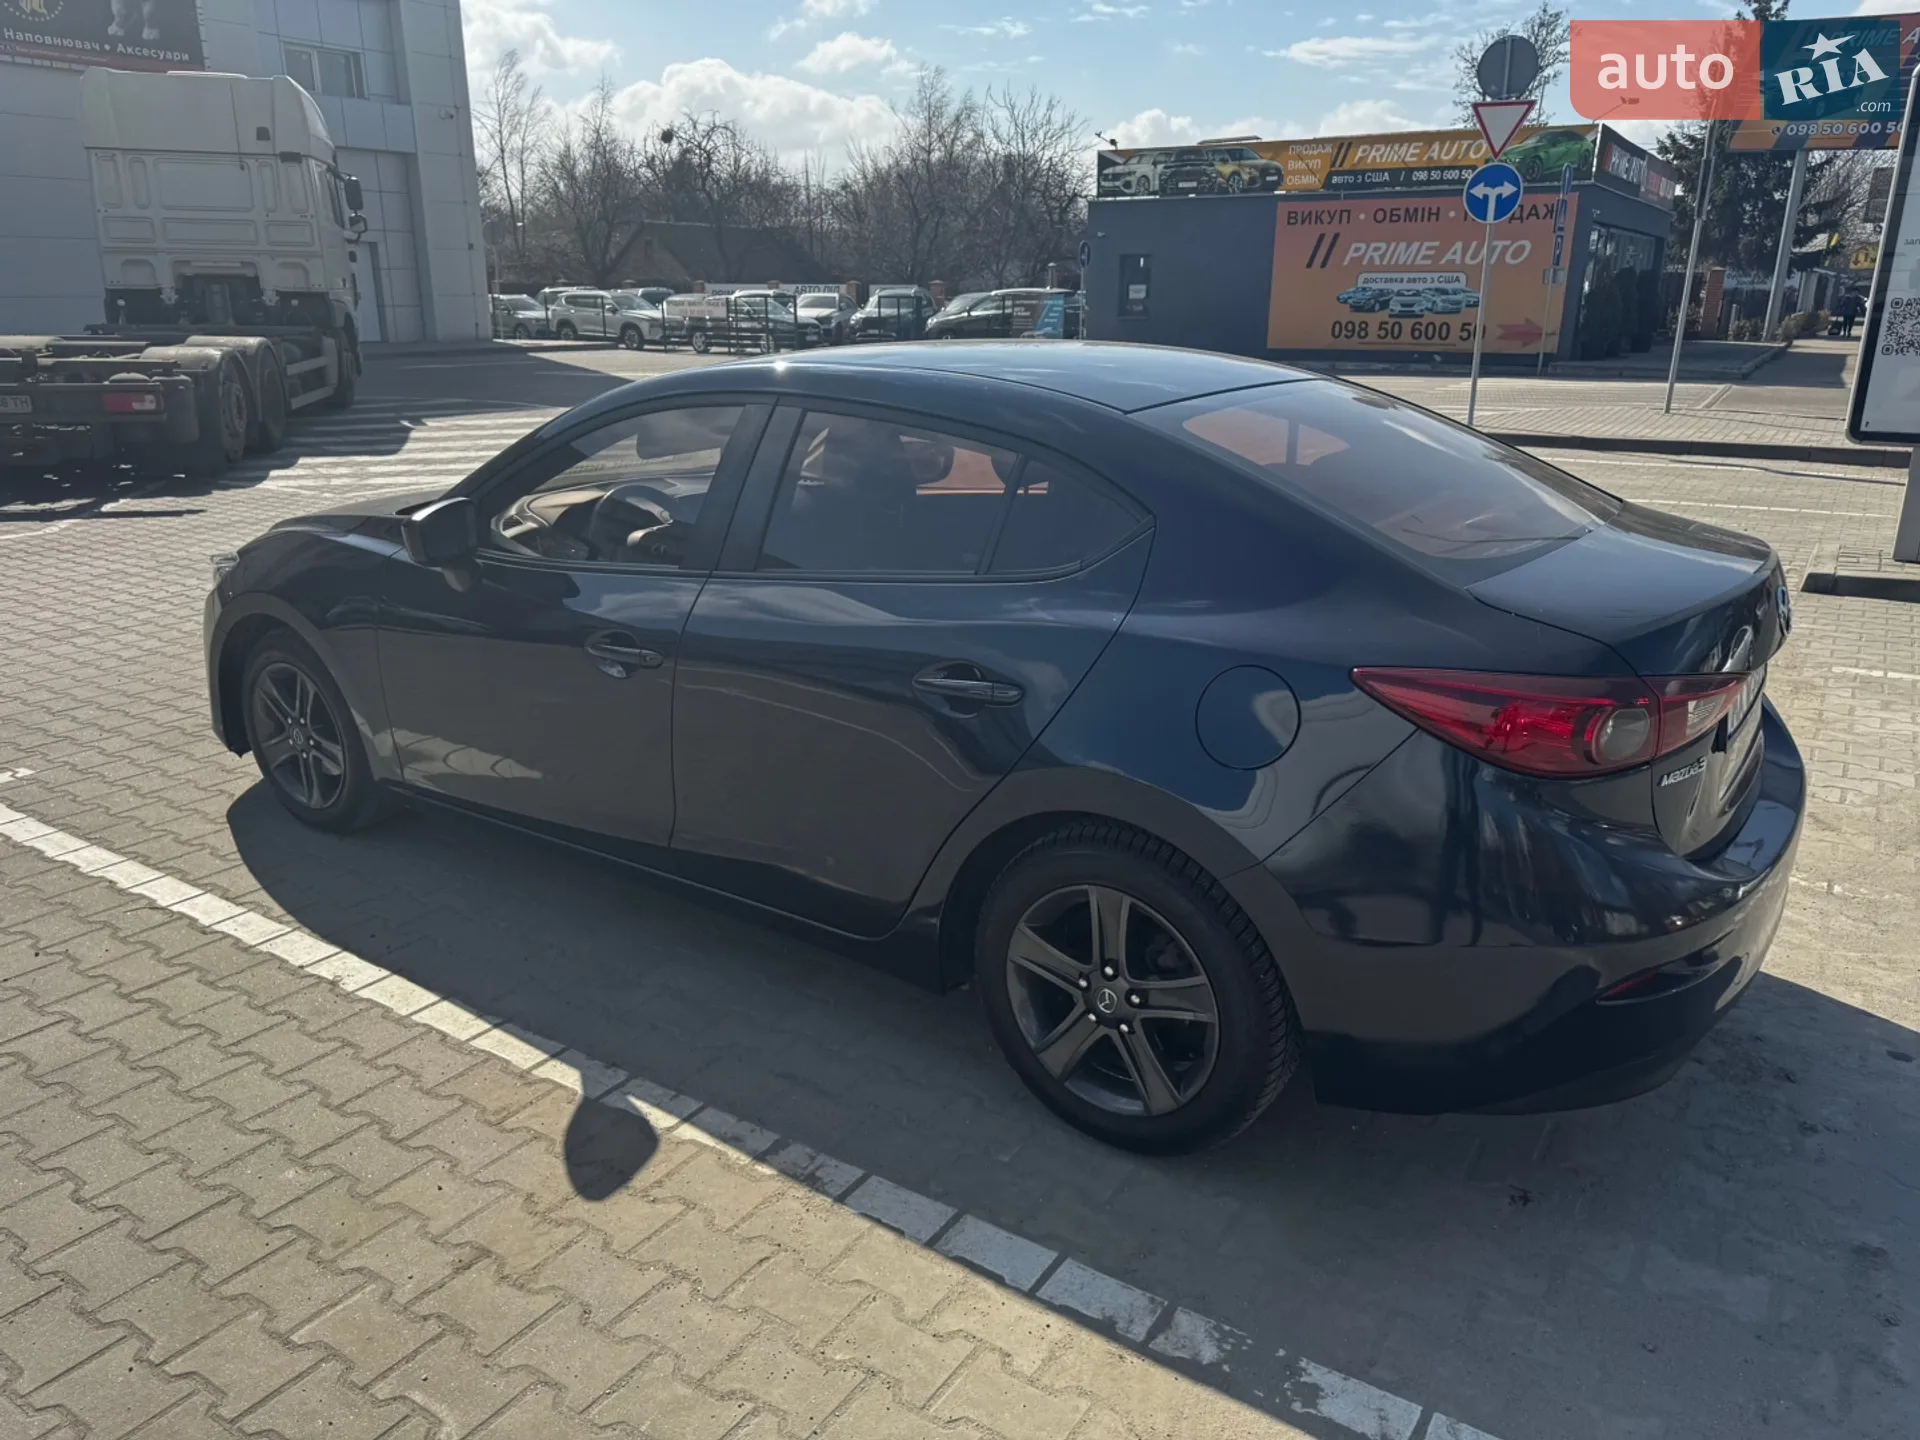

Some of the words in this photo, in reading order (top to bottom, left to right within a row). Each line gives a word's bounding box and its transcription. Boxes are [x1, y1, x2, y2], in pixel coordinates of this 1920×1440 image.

[3, 28, 100, 51] Наповнювач
[117, 43, 190, 62] Аксесуари
[1786, 124, 1818, 136] 098
[1821, 123, 1843, 135] 50
[1847, 122, 1882, 134] 600
[1288, 143, 1333, 155] ПРОДАЖ
[1353, 142, 1423, 164] PRIME
[1423, 138, 1487, 161] AUTO
[1287, 159, 1322, 170] ВИКУП
[1286, 174, 1319, 186] ОБМІН
[1331, 175, 1354, 184] авто
[1364, 172, 1390, 184] США
[1411, 170, 1428, 181] 098
[1430, 170, 1441, 180] 50
[1442, 169, 1460, 180] 600
[1461, 169, 1473, 179] 50
[1286, 209, 1351, 226] ВИКУП
[1373, 207, 1440, 223] ОБМІН
[1463, 203, 1556, 224] ДАЖ
[1343, 241, 1439, 266] PRIME
[1441, 239, 1532, 264] AUTO
[1362, 276, 1404, 285] доставка
[1406, 276, 1427, 284] авто
[1437, 274, 1461, 284] США
[1331, 320, 1369, 339] 098
[1377, 321, 1402, 340] 50
[1410, 321, 1450, 340] 600
